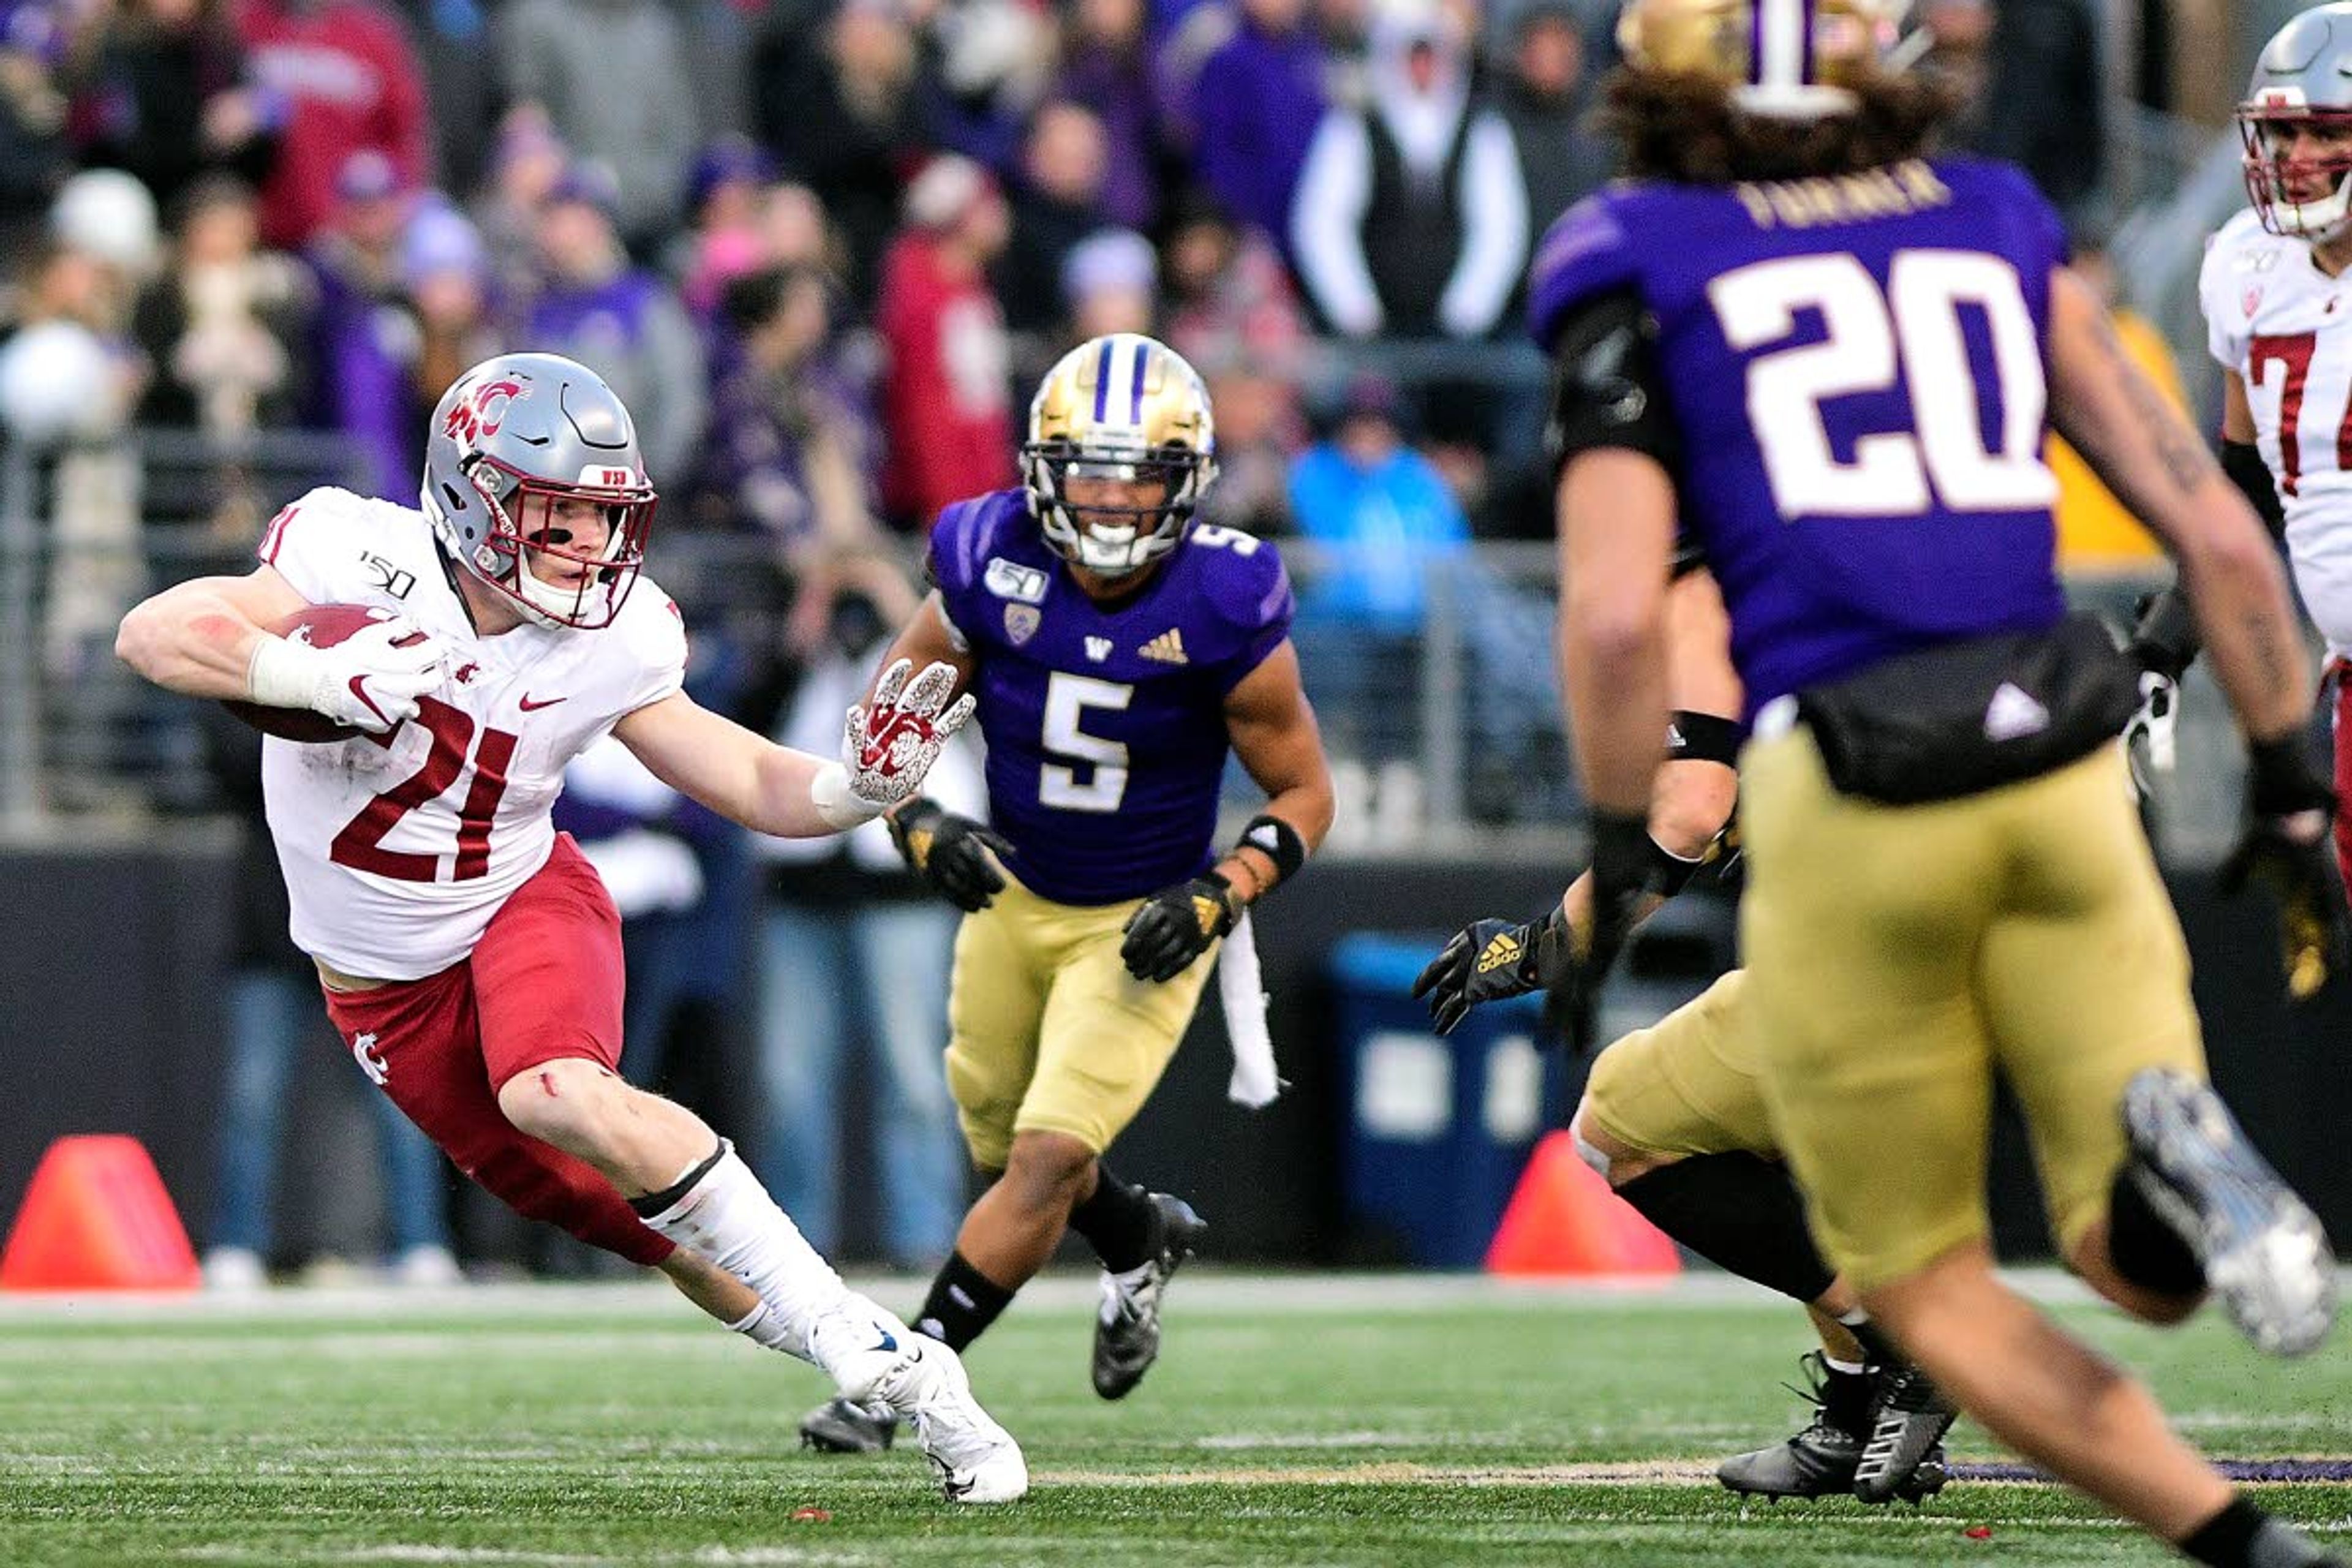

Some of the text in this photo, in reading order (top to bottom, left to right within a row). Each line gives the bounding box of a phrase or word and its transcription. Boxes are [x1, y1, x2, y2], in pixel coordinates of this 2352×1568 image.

[1708, 246, 2062, 518] 20
[2249, 331, 2352, 498] 7
[330, 695, 518, 883] 21
[1039, 671, 1134, 813] 5
